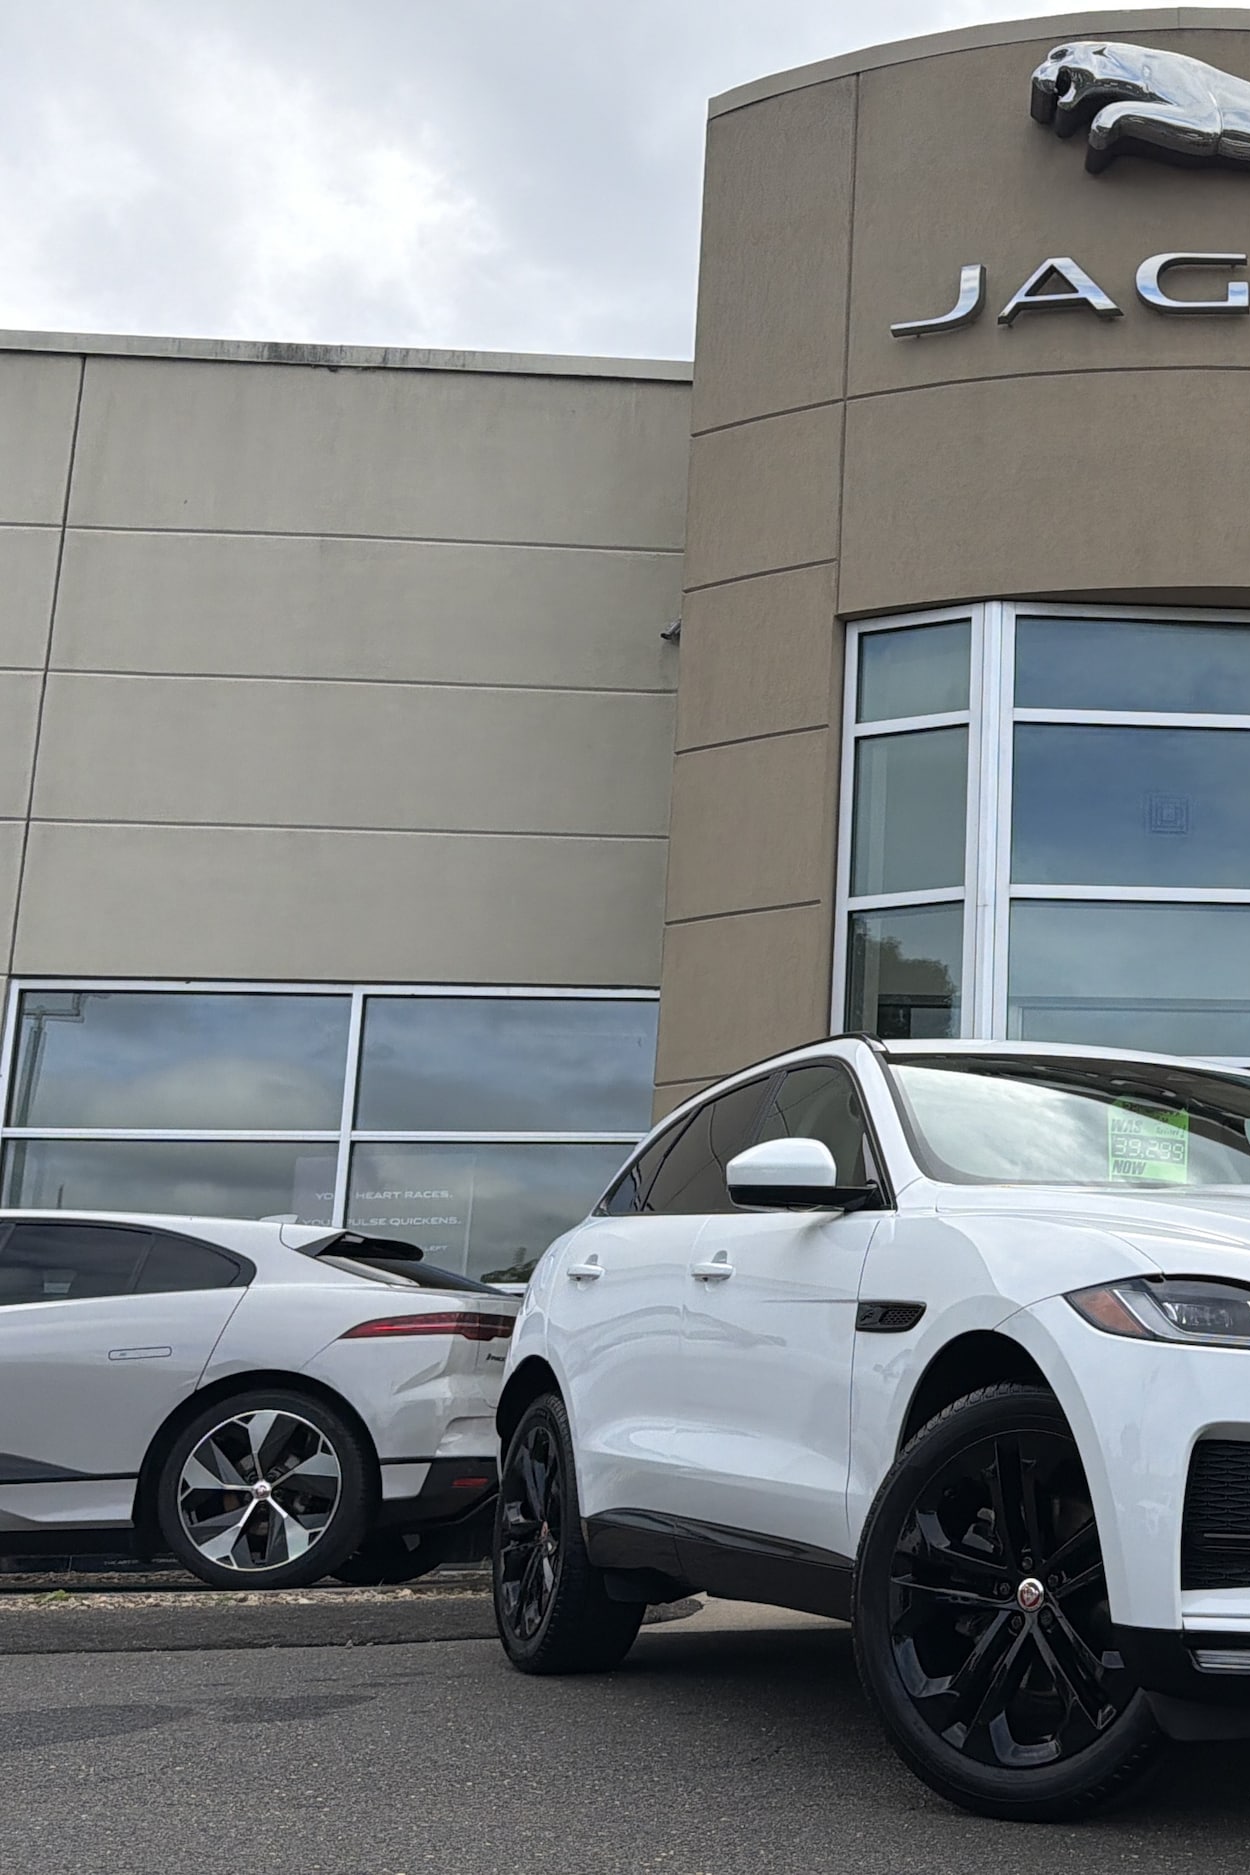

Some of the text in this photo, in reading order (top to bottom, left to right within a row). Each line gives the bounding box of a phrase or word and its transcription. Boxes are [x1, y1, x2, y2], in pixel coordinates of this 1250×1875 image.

[1112, 1118, 1142, 1133] WAS
[1114, 1137, 1185, 1161] 39,299
[1113, 1160, 1147, 1175] NOW
[355, 1191, 401, 1200] HEART
[404, 1190, 454, 1200] RACES.
[389, 1216, 462, 1227] QUICKENS.
